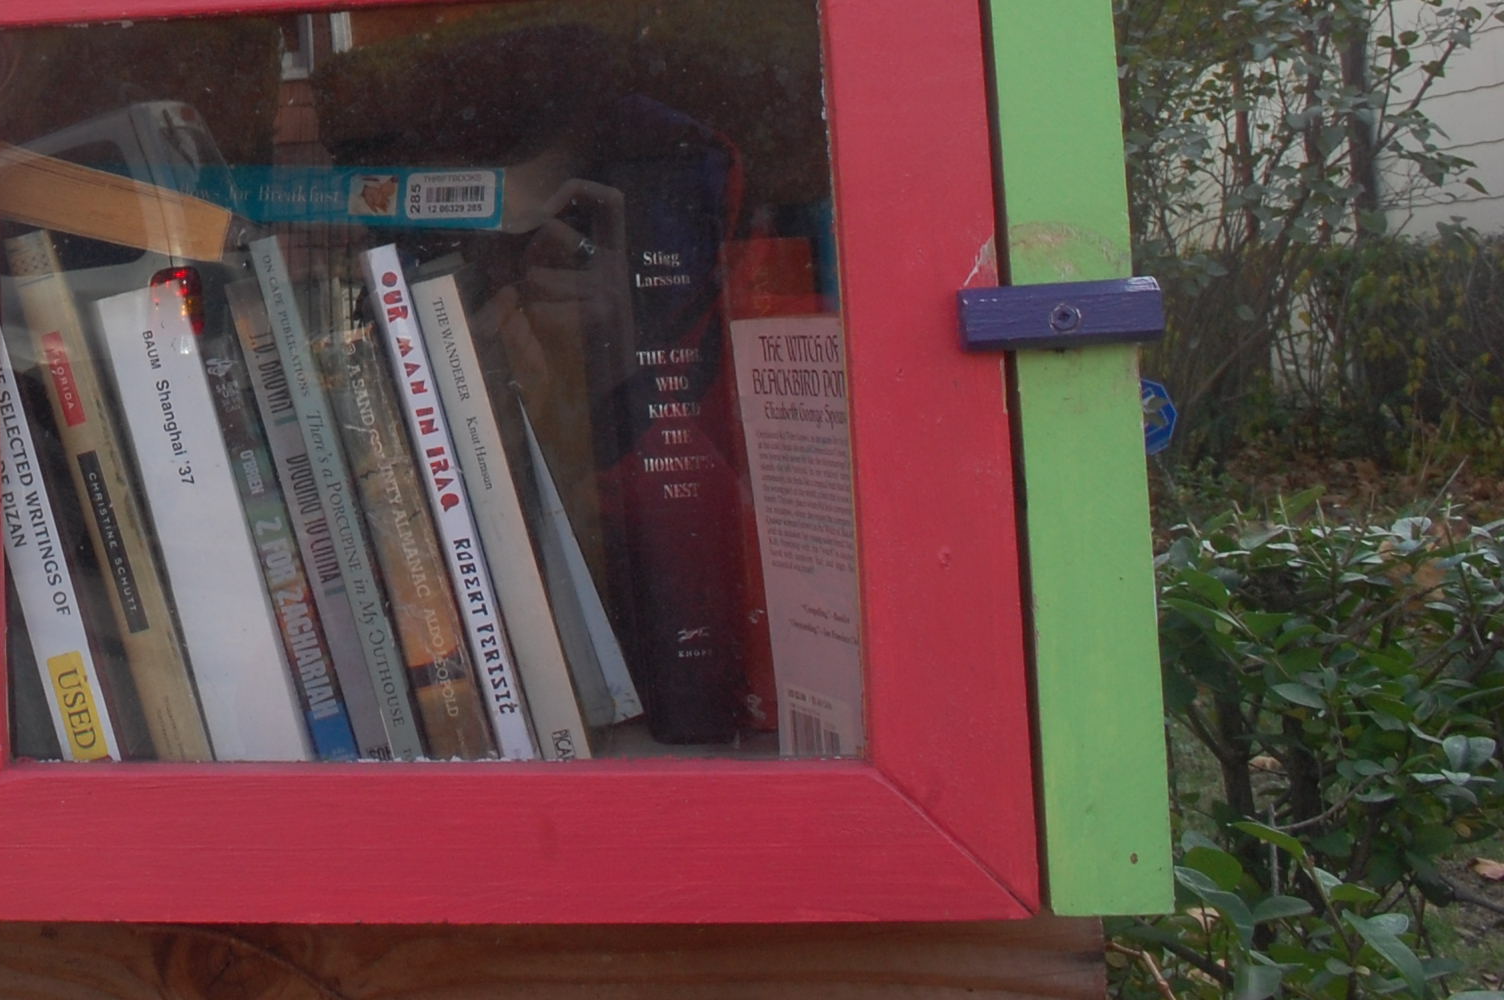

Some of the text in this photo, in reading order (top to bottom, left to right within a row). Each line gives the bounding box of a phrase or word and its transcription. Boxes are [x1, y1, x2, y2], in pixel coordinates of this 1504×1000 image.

[409, 183, 422, 214] 285
[635, 272, 691, 288] Larsson
[266, 275, 285, 307] CAPE
[277, 309, 311, 398] PUBLICATIONS
[430, 296, 471, 401] THE WANDERER
[635, 349, 666, 366] THE
[758, 335, 839, 363] THE WITCH OF
[140, 328, 162, 370] BAUM
[155, 377, 188, 457] Shanghai
[378, 270, 461, 512] OUR MAN IN IRAQ
[647, 402, 701, 420] KICKED
[655, 375, 689, 392] WHO
[752, 368, 846, 398] BLACKBIRD PON
[304, 409, 334, 465] There's
[464, 415, 496, 491] Knut Hamsun
[661, 429, 693, 446] THE
[237, 448, 265, 495] O'BRIEN
[351, 377, 376, 426] SAND
[392, 507, 430, 598] ALMANAC
[663, 482, 700, 500] NEST
[23, 490, 63, 587] WRITINGS
[50, 589, 71, 618] OF
[87, 471, 138, 612] CHRISTINE SCHUTT
[325, 479, 363, 573] PORCUPINE
[352, 576, 371, 596] in
[454, 537, 488, 618] ROBERT
[253, 514, 339, 721] Z FOR ZACHARIAH
[353, 597, 380, 628] My
[424, 607, 459, 717] ALDO LEOPOLD
[55, 667, 99, 751] USED
